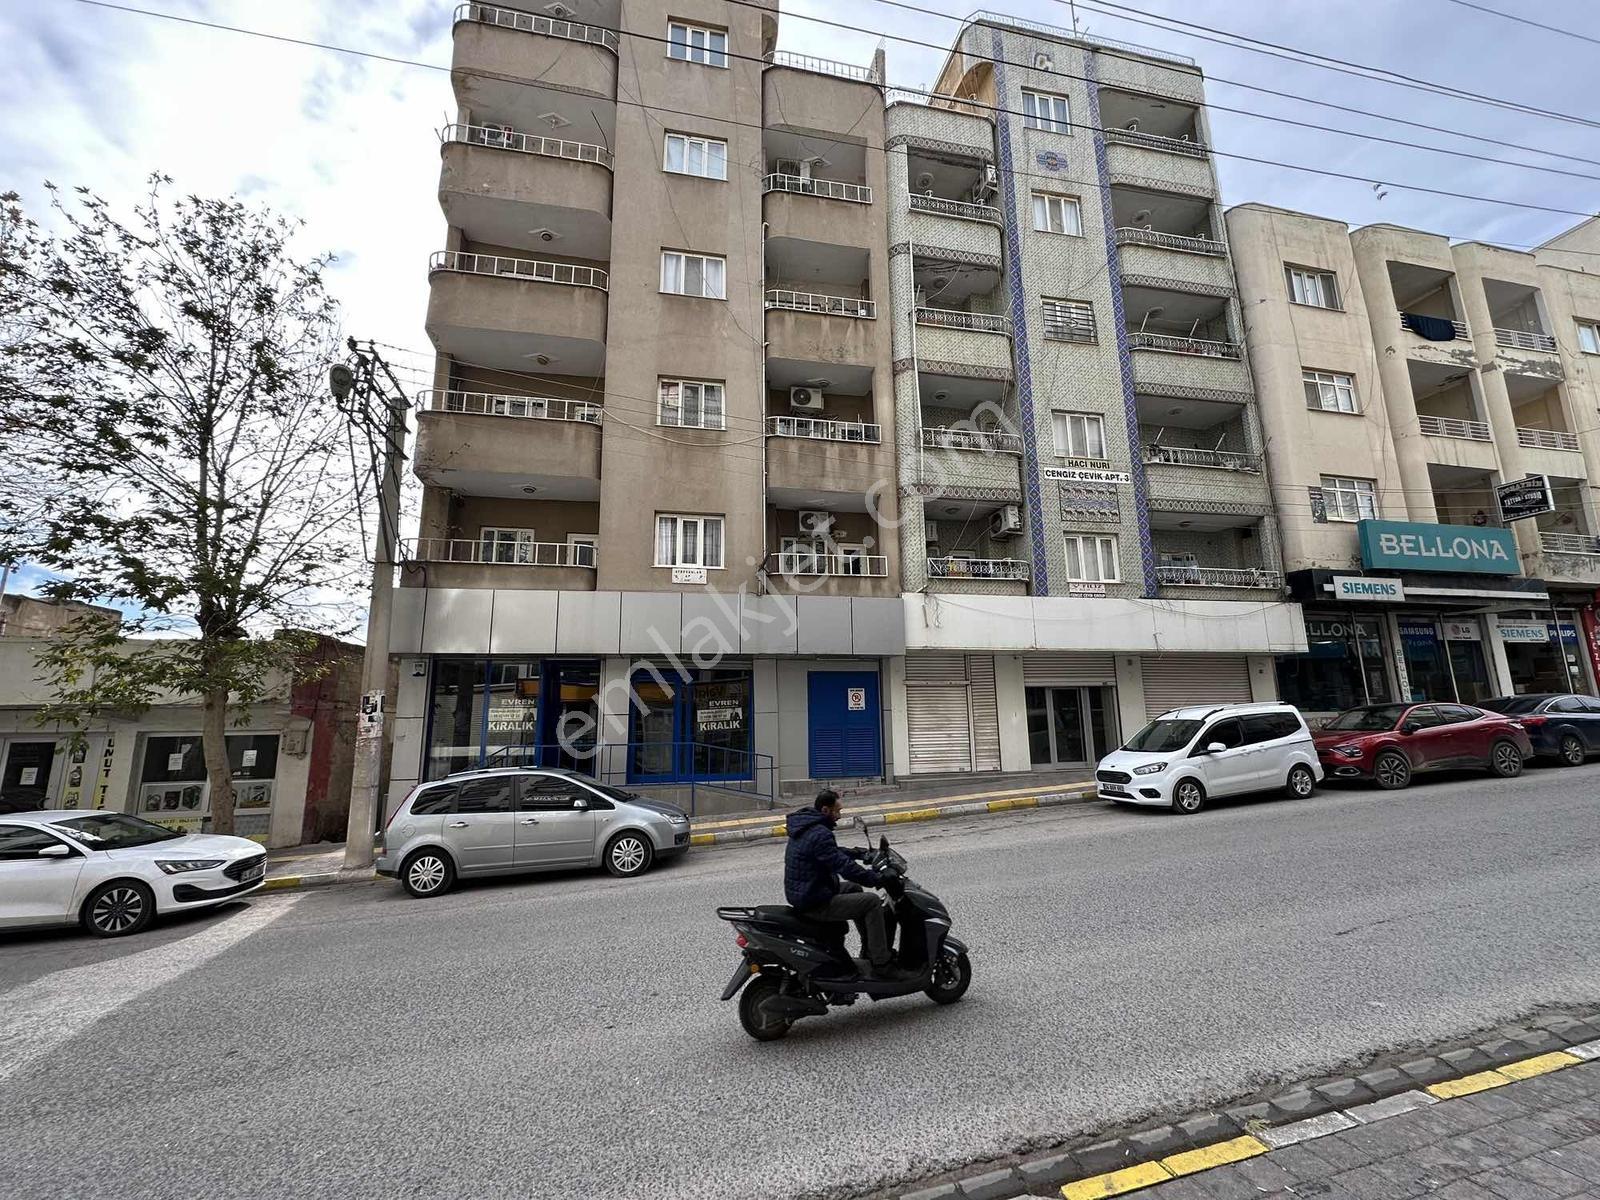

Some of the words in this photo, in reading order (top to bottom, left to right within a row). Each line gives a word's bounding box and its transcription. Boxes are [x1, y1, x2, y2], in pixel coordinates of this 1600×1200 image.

[1068, 460, 1088, 468] HACI
[1380, 533, 1509, 561] BELLONA
[1342, 582, 1397, 595] SIEMENS
[1399, 626, 1434, 636] SAMSUNG
[1500, 628, 1544, 638] SIEMENS
[708, 699, 739, 707] EVREN
